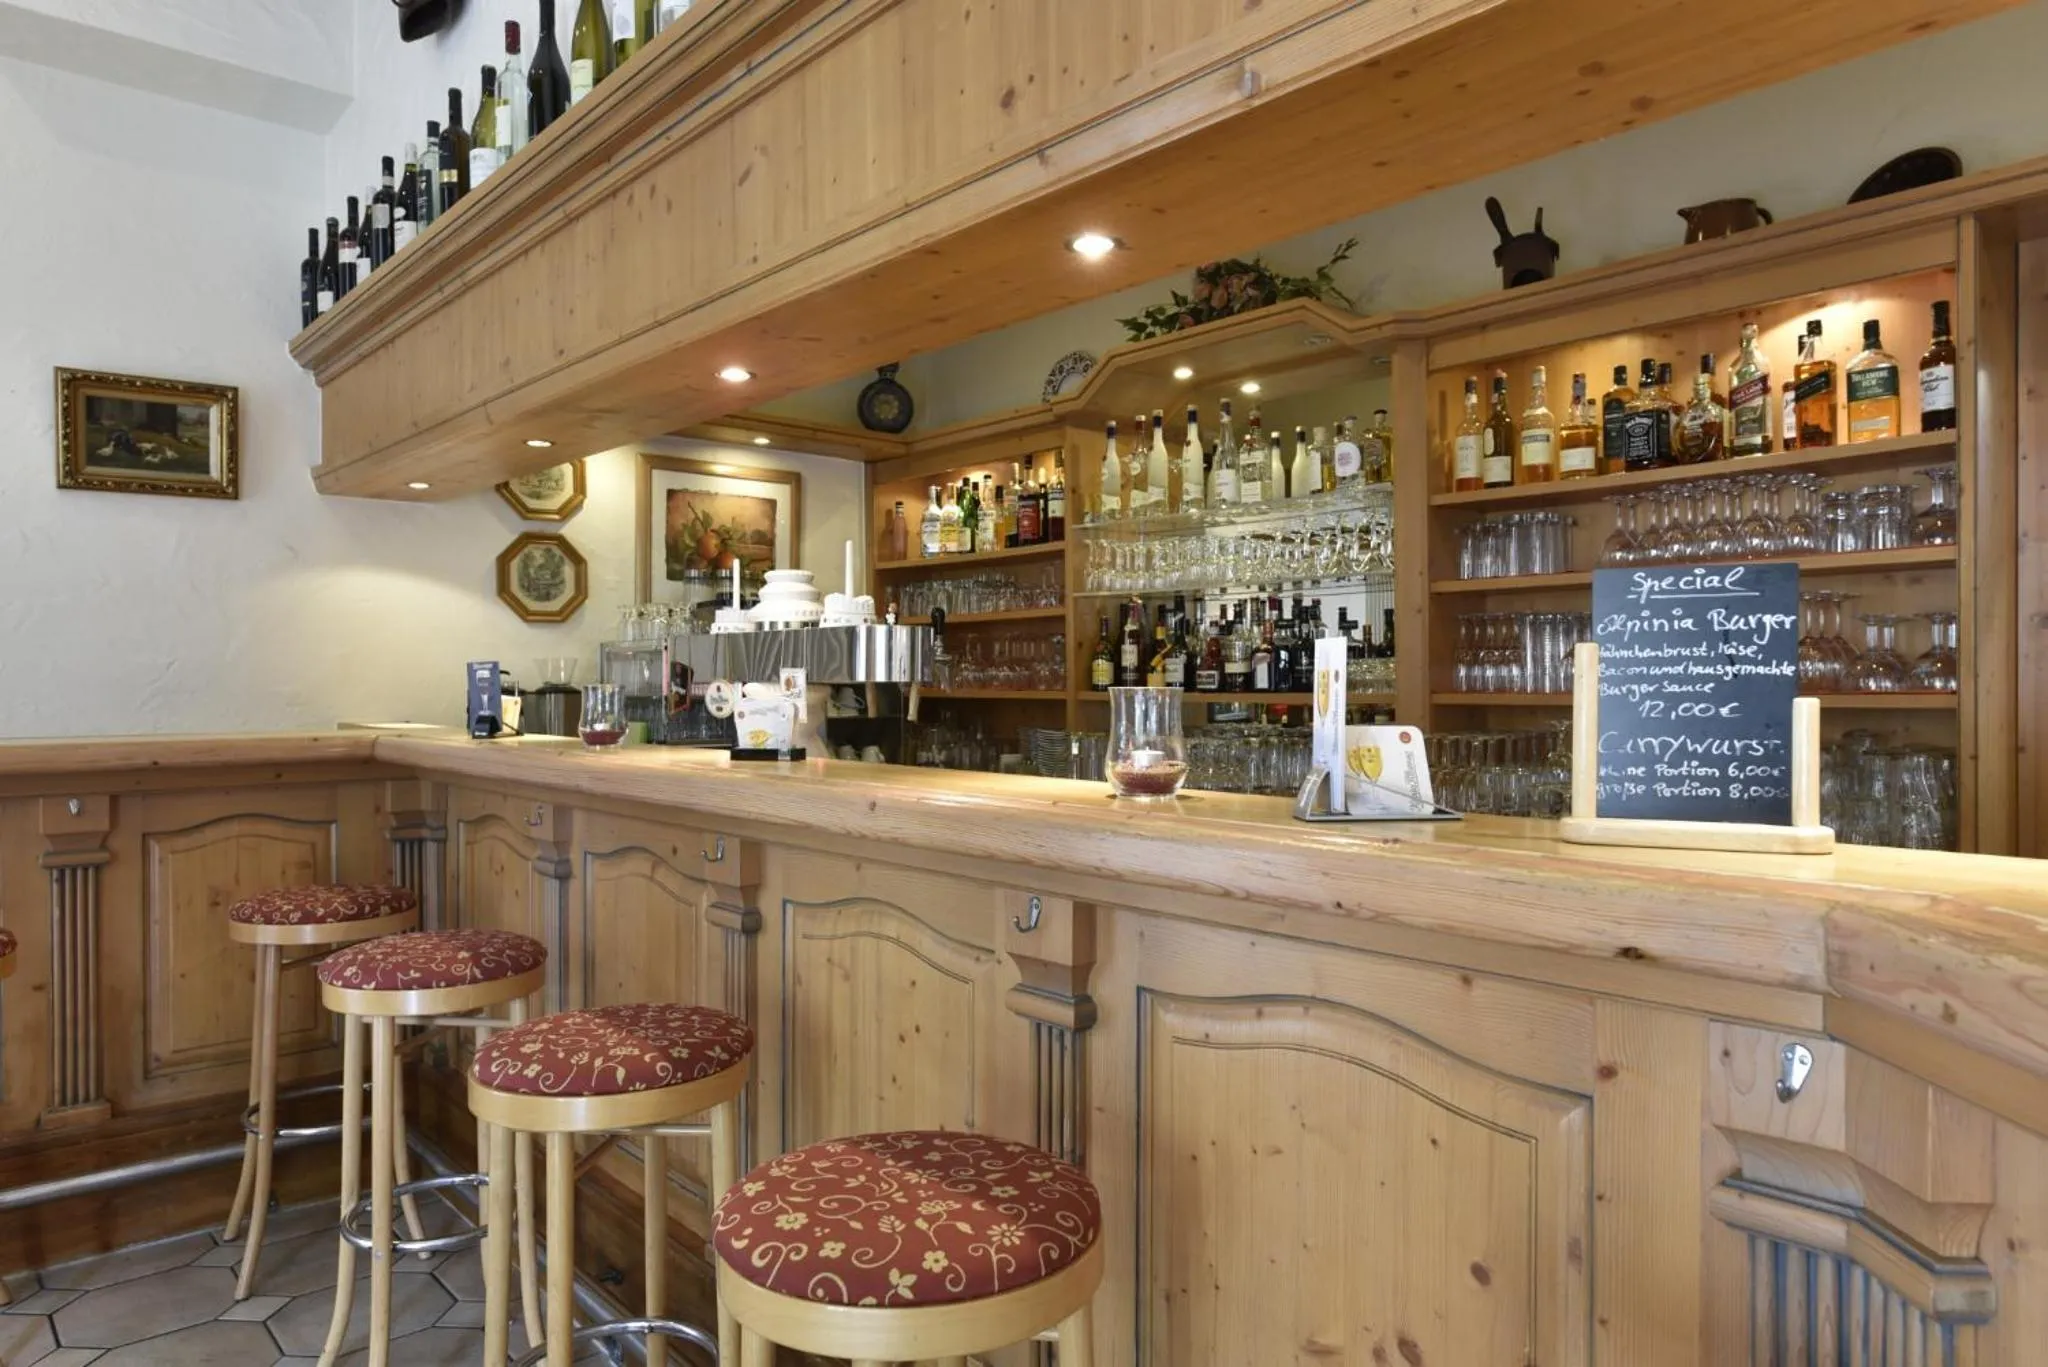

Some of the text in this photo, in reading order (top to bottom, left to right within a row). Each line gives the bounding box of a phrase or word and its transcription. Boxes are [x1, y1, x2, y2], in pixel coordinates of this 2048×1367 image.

[1630, 567, 1746, 604] Special
[1706, 608, 1797, 644] Burger
[1649, 661, 1687, 676] und
[1687, 662, 1796, 680] hausgemachte
[1599, 680, 1715, 702] Burger Sauce
[1654, 760, 1720, 778] Portion
[1653, 780, 1721, 798] Portion
